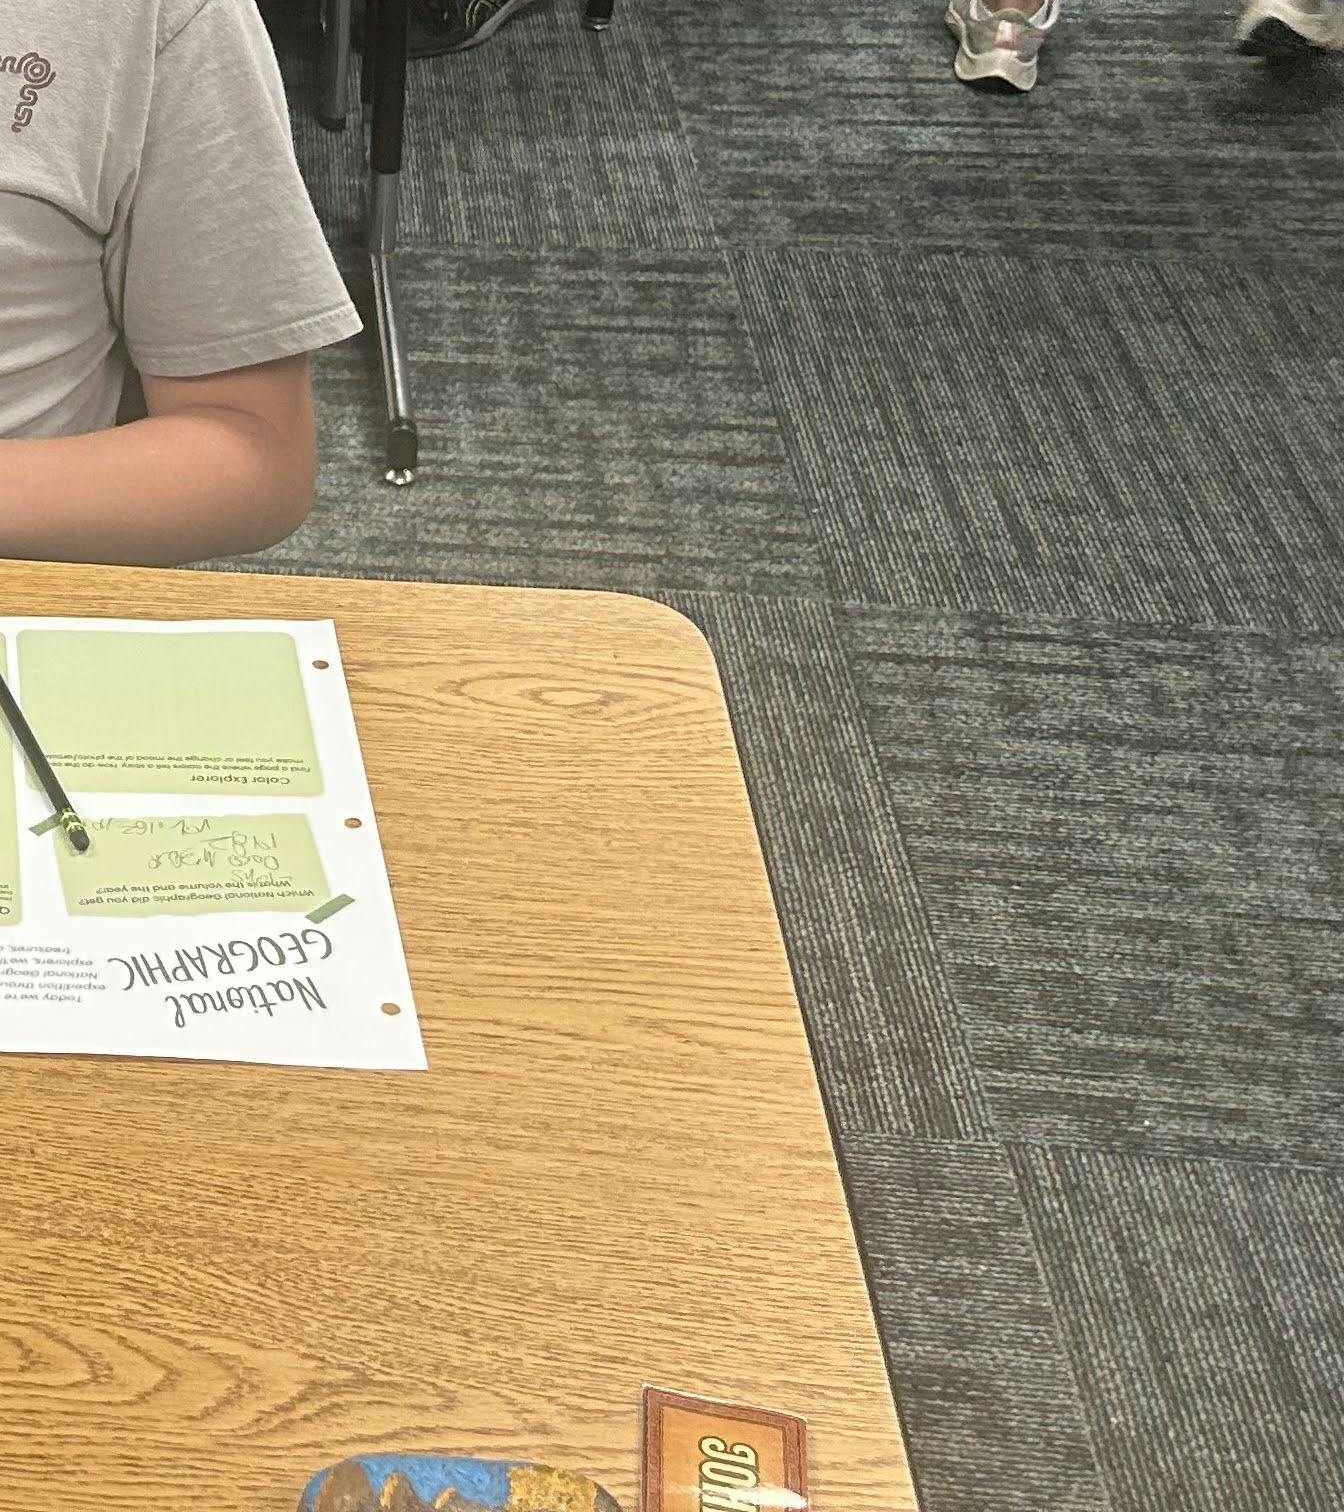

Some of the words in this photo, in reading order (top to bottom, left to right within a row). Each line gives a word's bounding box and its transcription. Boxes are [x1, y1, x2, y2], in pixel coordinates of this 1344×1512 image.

[190, 775, 248, 783] Explorer
[96, 885, 128, 894] year?
[78, 897, 104, 906] get?
[107, 896, 129, 904] you
[152, 893, 222, 902] Geographic
[107, 928, 332, 991] GEOGRAPHIC
[43, 970, 97, 979] National
[39, 982, 106, 990] expedition
[43, 992, 81, 1003] Today
[165, 977, 327, 1028] National
